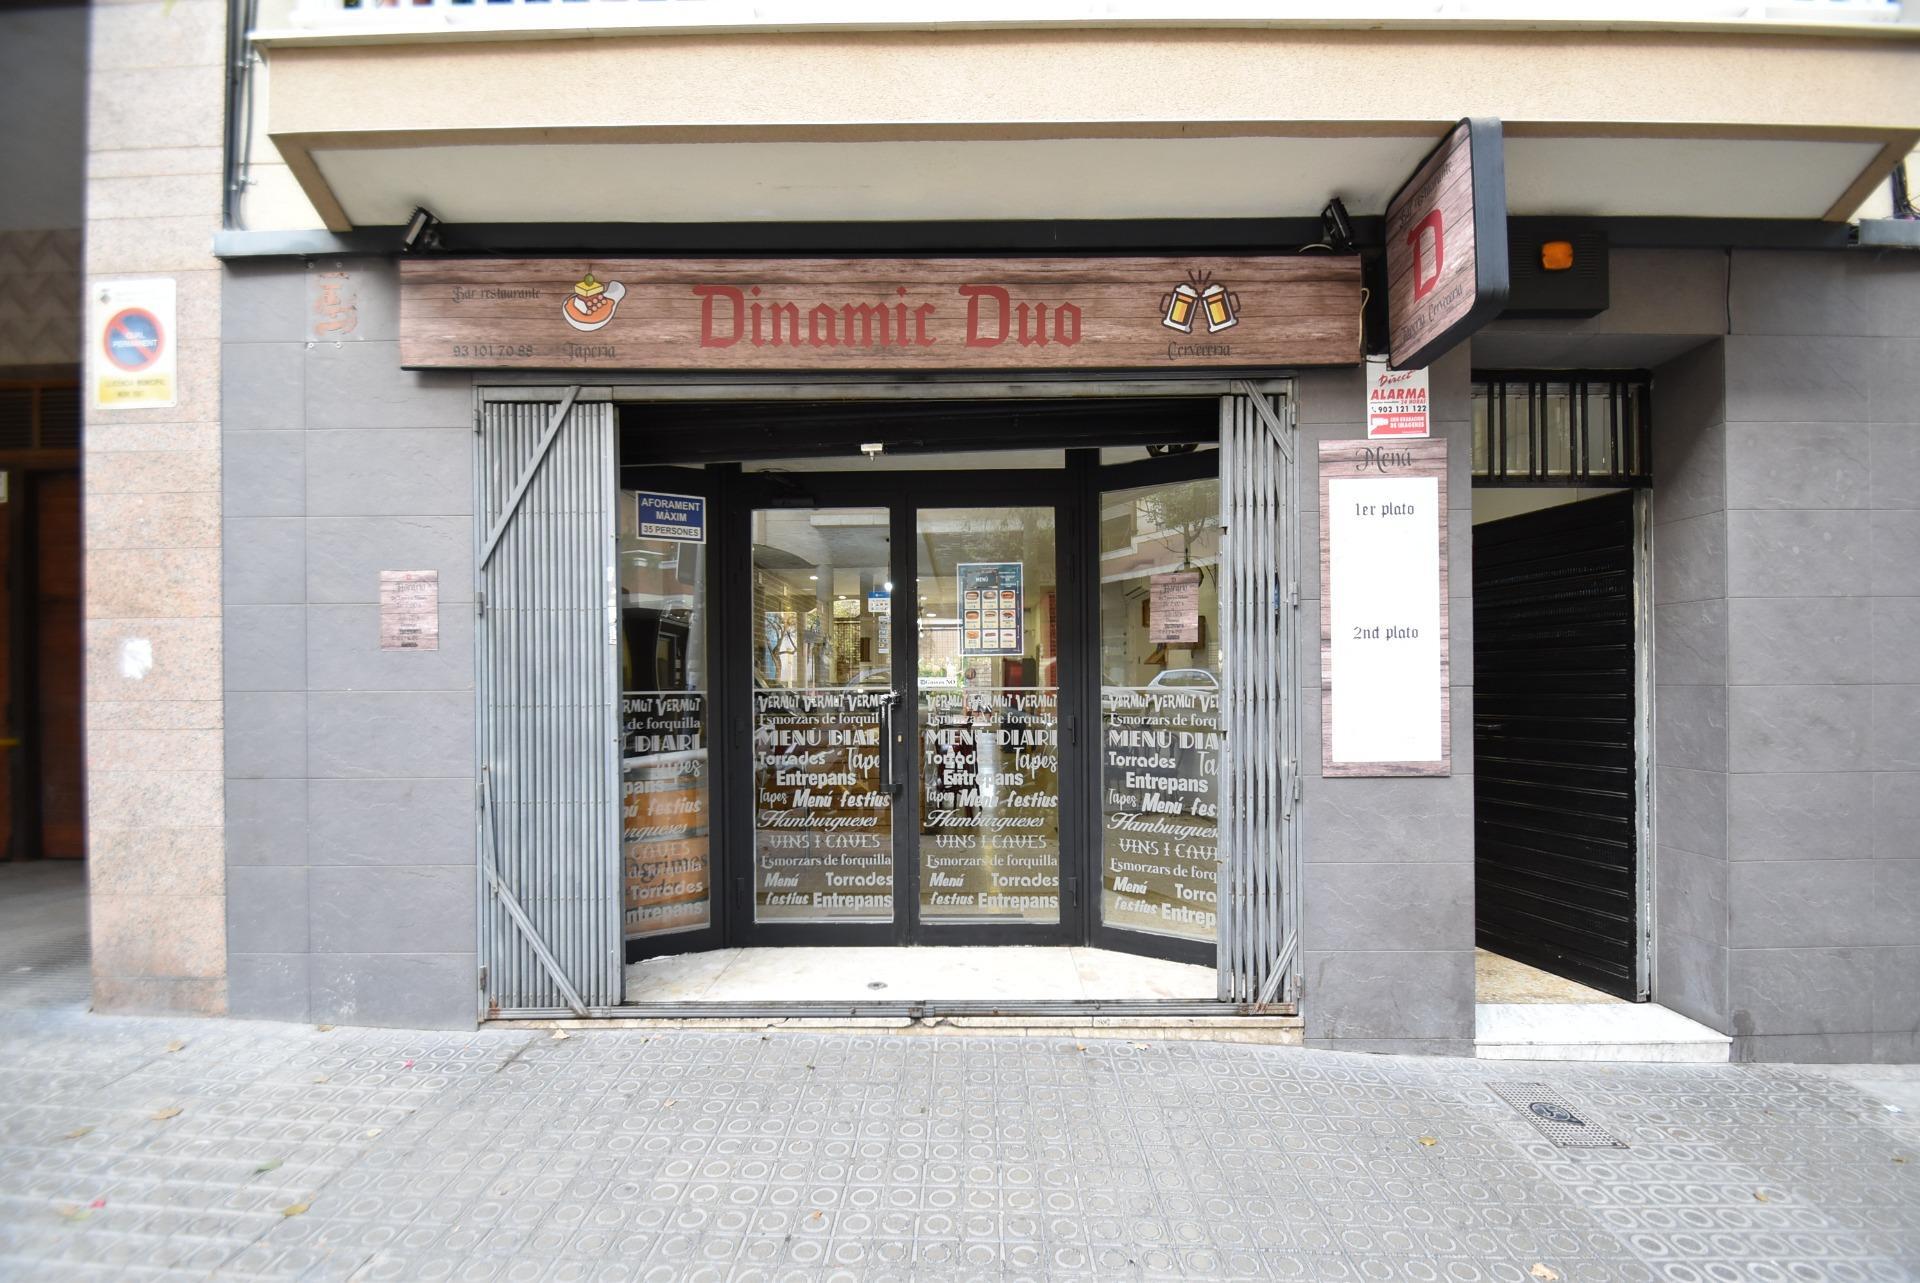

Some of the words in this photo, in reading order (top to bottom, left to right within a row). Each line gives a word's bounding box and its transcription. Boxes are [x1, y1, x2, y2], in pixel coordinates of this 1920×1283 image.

[1407, 208, 1444, 304] D
[452, 285, 475, 303] Bar
[481, 287, 541, 300] restaurante
[692, 284, 937, 349] Dinamic
[958, 284, 1083, 349] Duo
[453, 344, 470, 358] 93
[1370, 388, 1426, 401] ALARMA
[1396, 405, 1409, 413] 121
[1355, 446, 1412, 474] Menú
[641, 497, 701, 512] AFORAMENT
[1355, 502, 1377, 516] 1er
[1381, 502, 1415, 517] plato
[643, 525, 654, 533] 35
[655, 525, 699, 537] PERSONES
[1353, 625, 1379, 640] 2nd
[1386, 626, 1419, 640] plato
[623, 699, 653, 713] RMUT
[656, 698, 701, 716] VERMUT
[759, 694, 800, 712] VERMUT
[847, 693, 880, 712] VERM
[1015, 694, 1058, 711] VERMUT
[1152, 694, 1197, 712] VERMUT
[627, 717, 644, 730] de
[646, 717, 701, 733] forquilla
[821, 712, 837, 724] de
[839, 713, 880, 727] forquil
[990, 712, 1005, 725] de
[1007, 712, 1058, 727] forquilla
[1109, 712, 1171, 728] Esmorzars
[1173, 713, 1188, 726] de
[1191, 713, 1218, 731] forq
[635, 733, 701, 753] DIARI
[828, 729, 880, 746] DIAR
[996, 729, 1058, 746] DIARI
[1179, 731, 1218, 750] DIA
[758, 750, 825, 766] Torrades
[846, 746, 880, 779] Tape
[1013, 746, 1058, 779] Tapes
[1109, 751, 1176, 769] Torrades
[776, 770, 857, 789] Entrepans
[1126, 771, 1209, 795] Entrepans
[759, 787, 788, 808] Tapes
[792, 789, 833, 808] Menú
[840, 790, 891, 808] festius
[1006, 790, 1058, 808] festius
[1108, 788, 1137, 811] Tapes
[1142, 792, 1185, 815] Menú
[757, 809, 878, 832] Hamburgueses
[923, 809, 1045, 833] Hamburgueses
[769, 834, 810, 848] VINS
[936, 834, 976, 849] VINS
[1119, 838, 1159, 856] VINS
[761, 855, 822, 869] Esmorzars
[824, 854, 839, 867] de
[841, 853, 891, 868] forquilla
[990, 854, 1005, 867] de
[1007, 854, 1058, 869] forquilla
[929, 872, 965, 887] Menú
[991, 872, 1059, 887] Torrades
[1110, 857, 1171, 873] Esmorzars
[1173, 863, 1188, 877] de
[1191, 864, 1217, 884] forq
[764, 872, 800, 888] Menú
[825, 872, 893, 887] Torrades
[1113, 876, 1148, 895] Menú
[1175, 883, 1217, 904] Torra
[766, 891, 809, 905] festius
[813, 892, 893, 911] Entrepans
[930, 891, 974, 905] festius
[978, 892, 1059, 912] Entrepans
[626, 901, 705, 925] ntrepans
[1115, 896, 1158, 914] festius
[1160, 902, 1217, 929] Entrep
